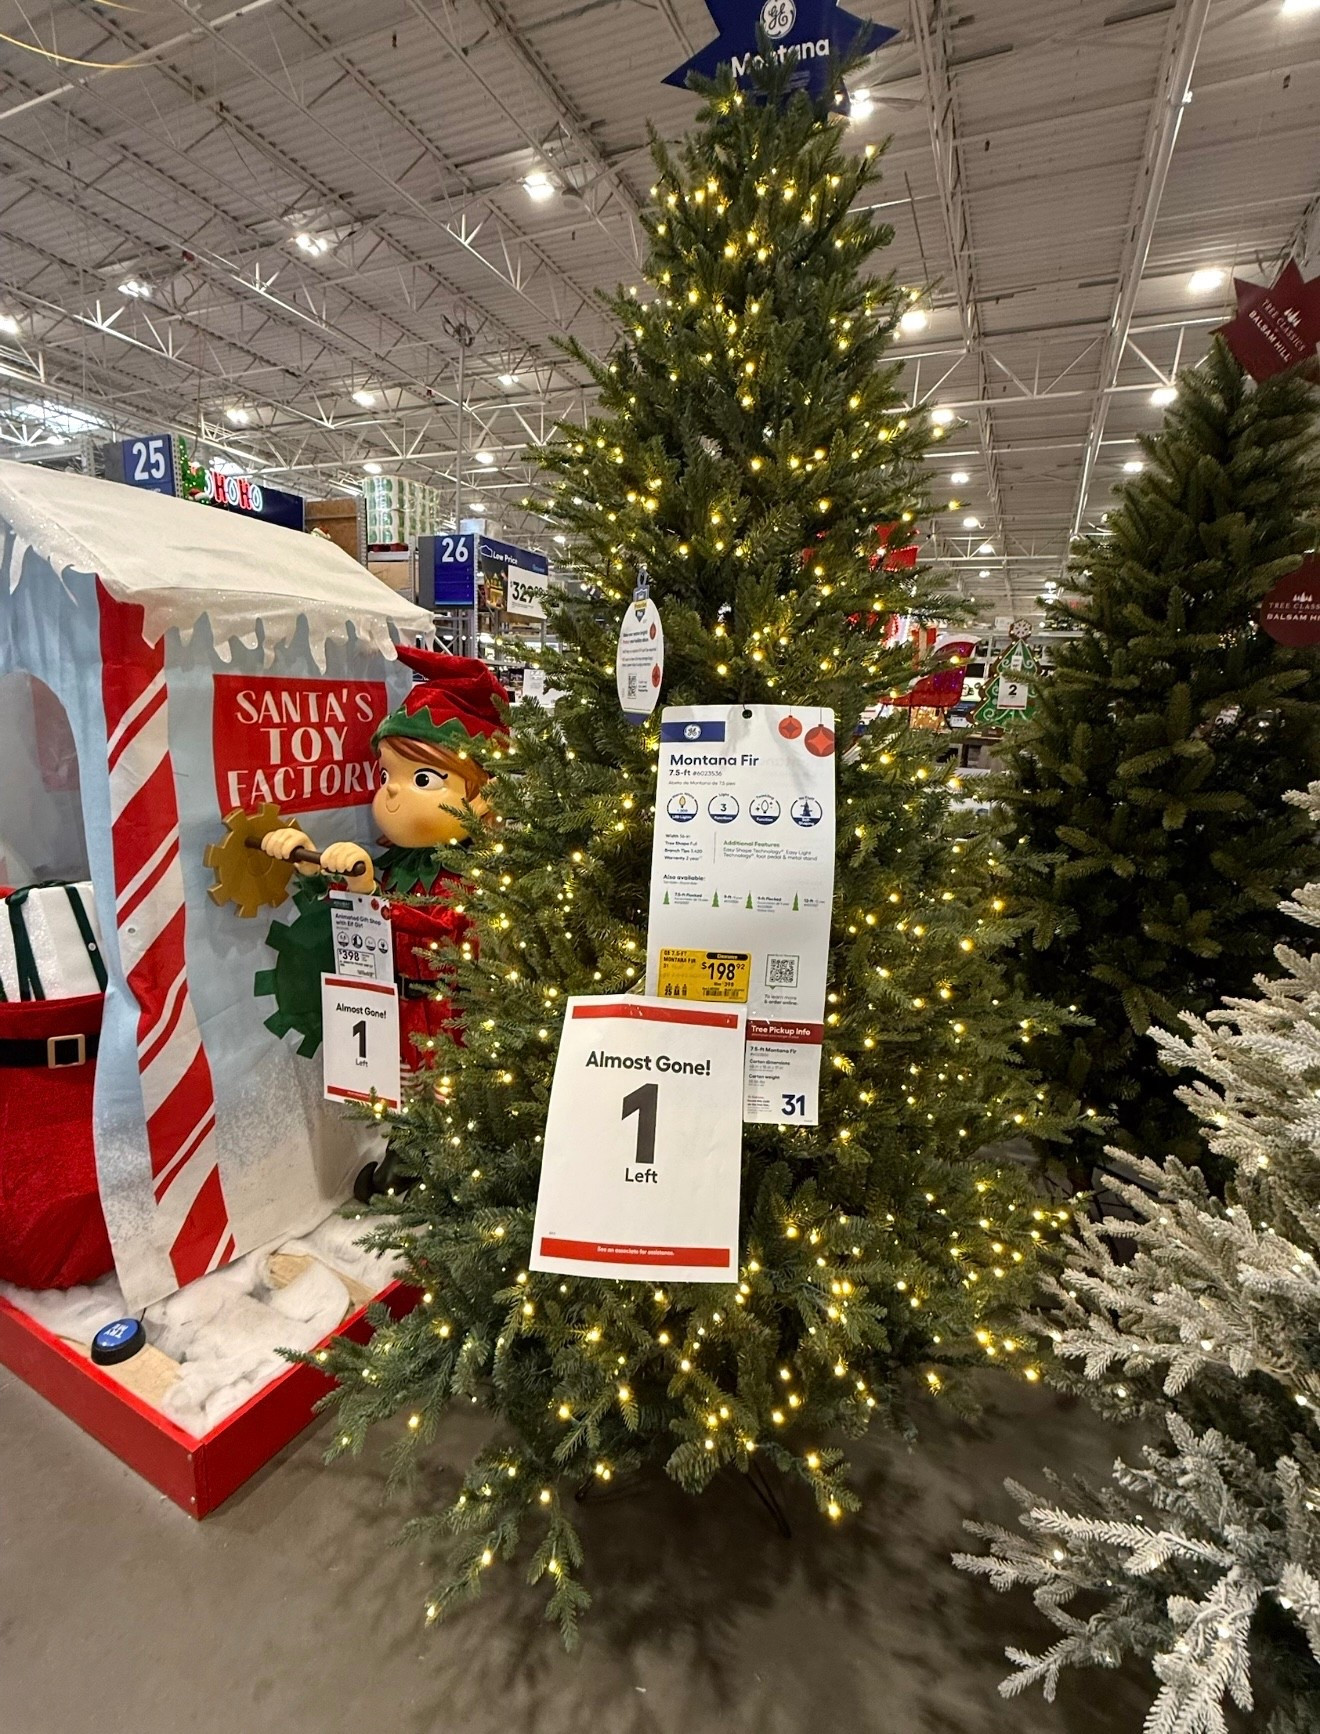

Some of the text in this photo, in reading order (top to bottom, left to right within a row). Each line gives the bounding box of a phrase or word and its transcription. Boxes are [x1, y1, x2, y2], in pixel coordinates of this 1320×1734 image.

[1262, 299, 1306, 352] TREE CLASSICS
[1248, 310, 1291, 363] BALSAM HILL
[132, 439, 165, 480] 25
[441, 537, 469, 563] 26
[493, 551, 518, 565] Low Price
[1267, 613, 1307, 621] BALSAM
[1008, 684, 1017, 696] 2
[235, 687, 374, 724] SANTA'S
[259, 726, 348, 765] TOY
[670, 754, 760, 766] Montana Fir
[227, 760, 378, 808] FACTORY
[720, 803, 727, 812] 3
[701, 961, 735, 981] $198
[336, 1002, 387, 1019] Almost Gone!
[352, 1020, 367, 1059] 1
[751, 1025, 811, 1036] Tree Pickup Info
[355, 1058, 368, 1067] Left
[585, 1050, 712, 1076] Almost Gone!
[781, 1094, 805, 1116] 31
[621, 1082, 659, 1165] 1
[624, 1167, 659, 1184] Left
[615, 1247, 639, 1255] associate
